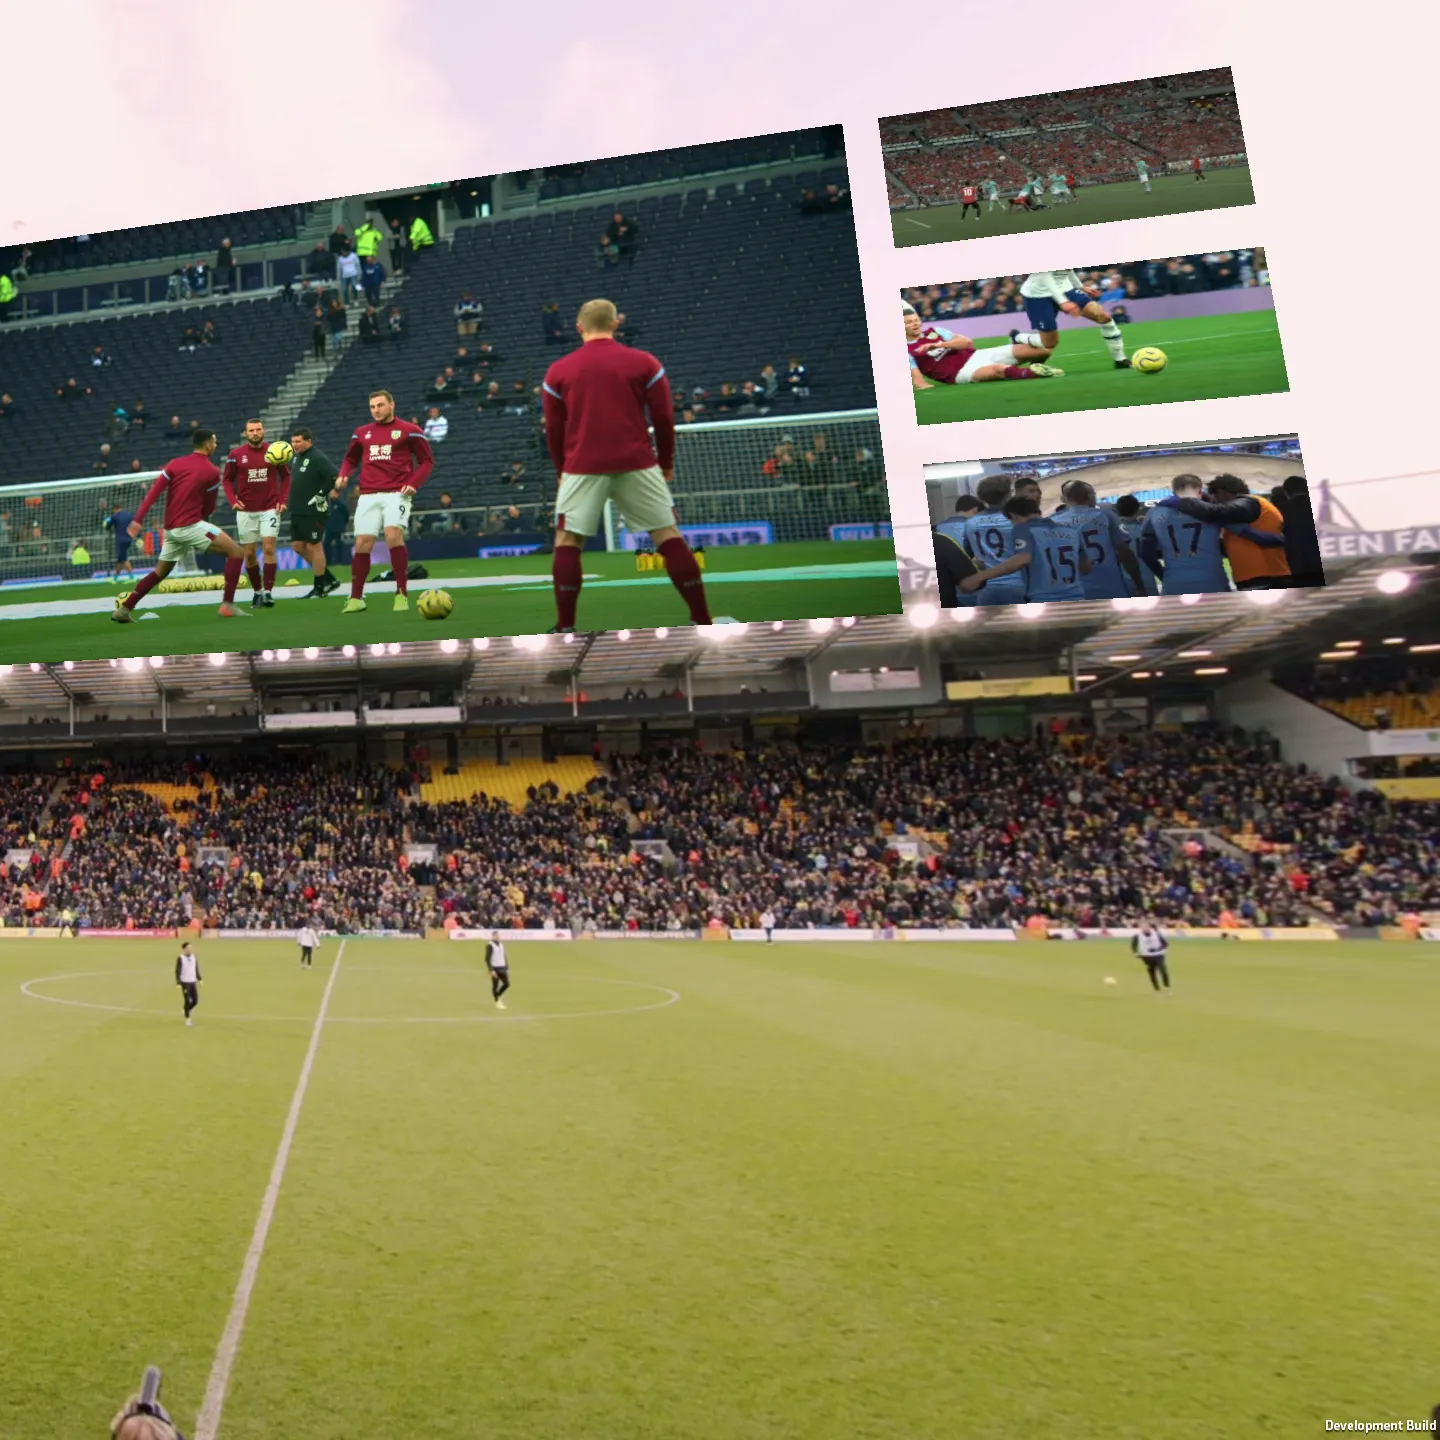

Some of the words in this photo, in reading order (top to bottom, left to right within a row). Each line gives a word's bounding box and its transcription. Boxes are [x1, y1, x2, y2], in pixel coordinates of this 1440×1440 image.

[269, 517, 277, 528] 2
[398, 504, 406, 516] 9
[974, 527, 1005, 560] 19
[1166, 521, 1202, 557] 17
[1394, 528, 1440, 553] FA
[1045, 544, 1077, 585] 15
